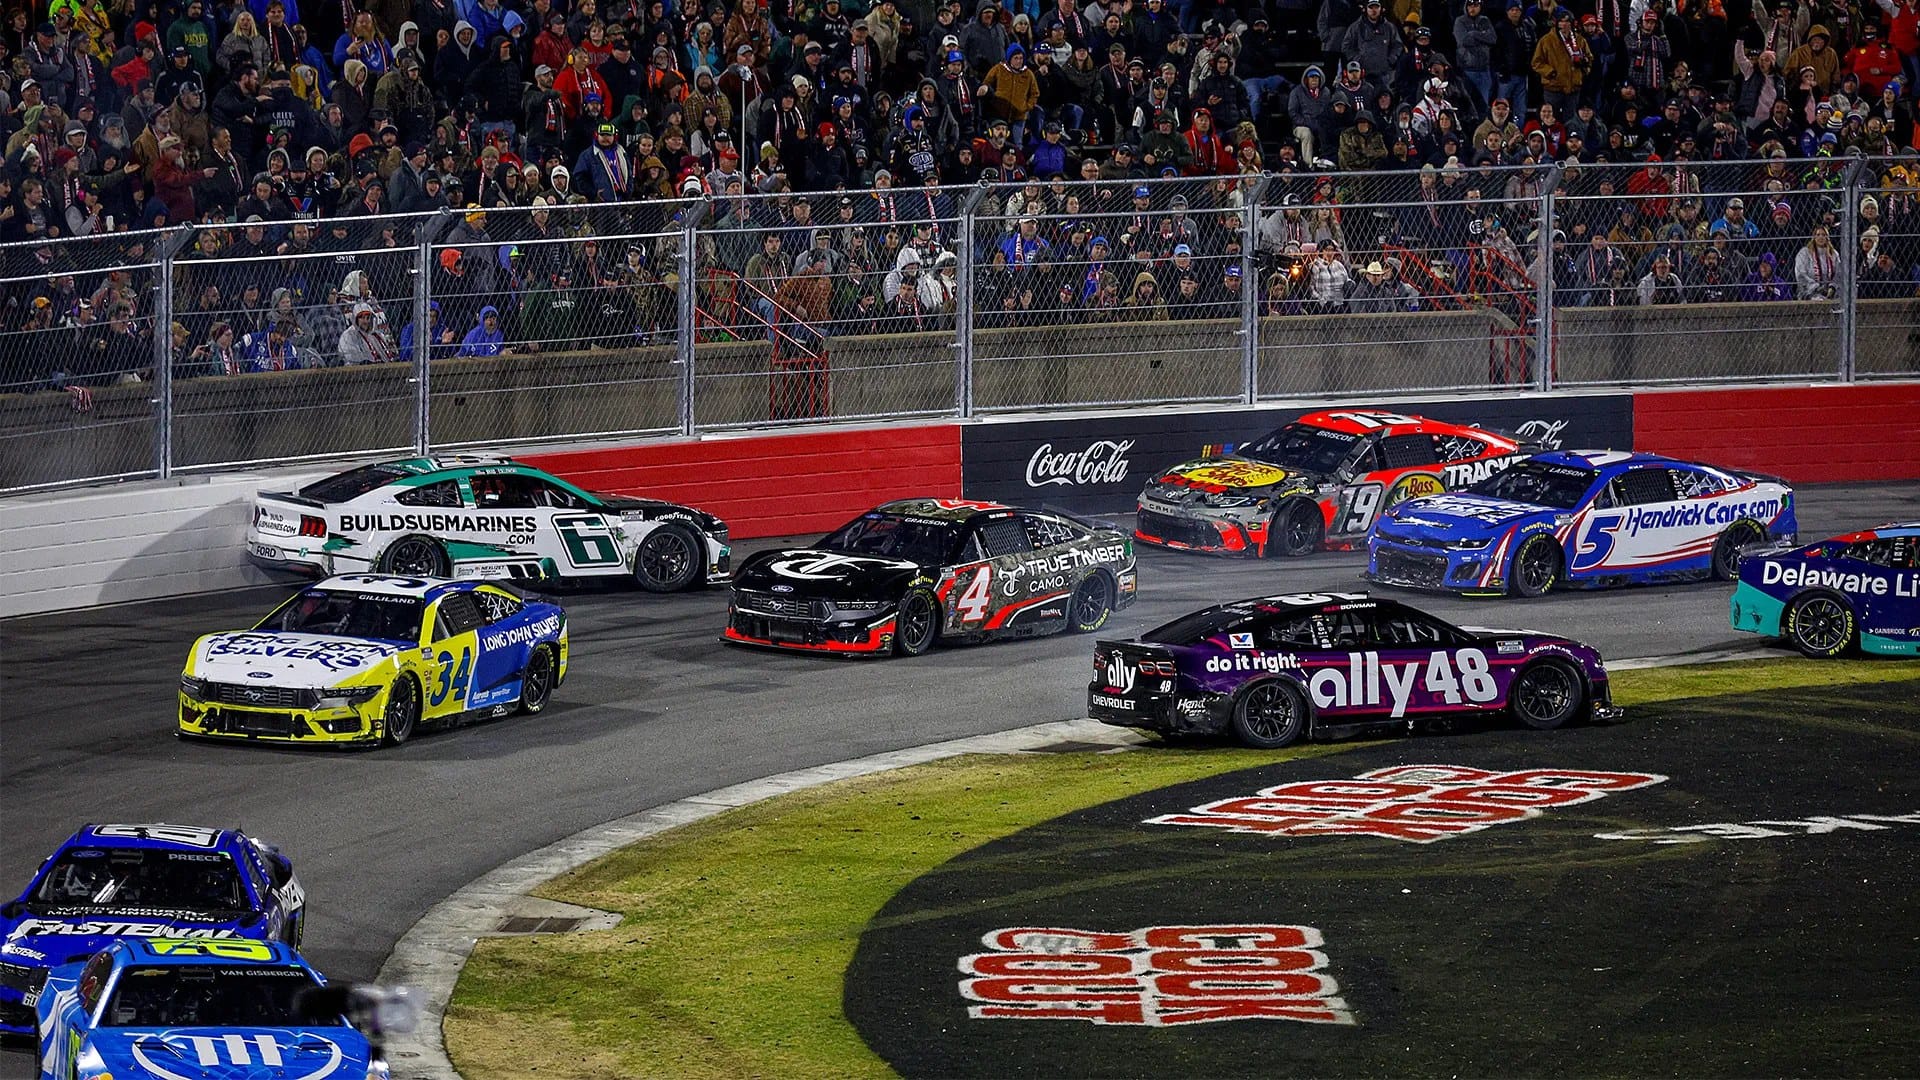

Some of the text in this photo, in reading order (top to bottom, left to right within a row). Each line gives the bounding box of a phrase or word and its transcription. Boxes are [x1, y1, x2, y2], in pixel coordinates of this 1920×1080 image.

[1316, 430, 1355, 442] BRISCOE
[1026, 439, 1136, 487] Coca-Cola
[1549, 466, 1588, 477] LARSON
[1409, 477, 1434, 498] Bass
[655, 511, 692, 521] GOODYEAR
[1338, 486, 1383, 533] 19
[340, 514, 537, 533] BUILDSUBMARINES
[905, 517, 949, 527] GRAGSON
[505, 534, 535, 546] .COM
[553, 514, 623, 566] 6
[1572, 514, 1624, 570] 5
[256, 546, 277, 558] FORD
[1763, 560, 1888, 596] Delaware
[358, 594, 415, 605] GILLILAND
[957, 563, 992, 622] 4
[1340, 602, 1377, 610] BOWMAN
[1788, 607, 1797, 633] EAGLE
[482, 637, 507, 652] LONG
[507, 628, 533, 645] JOHN
[1528, 644, 1574, 656] GOODYEAR
[1206, 656, 1232, 673] do
[1235, 653, 1250, 671] it
[430, 647, 471, 707] 34
[1107, 656, 1136, 695] ally
[1310, 648, 1498, 718] ally 48
[1160, 680, 1172, 693] 48
[1092, 694, 1136, 711] CHEVROLET
[168, 853, 221, 862] PREECE
[220, 969, 304, 978] VAN GISBERGEN
